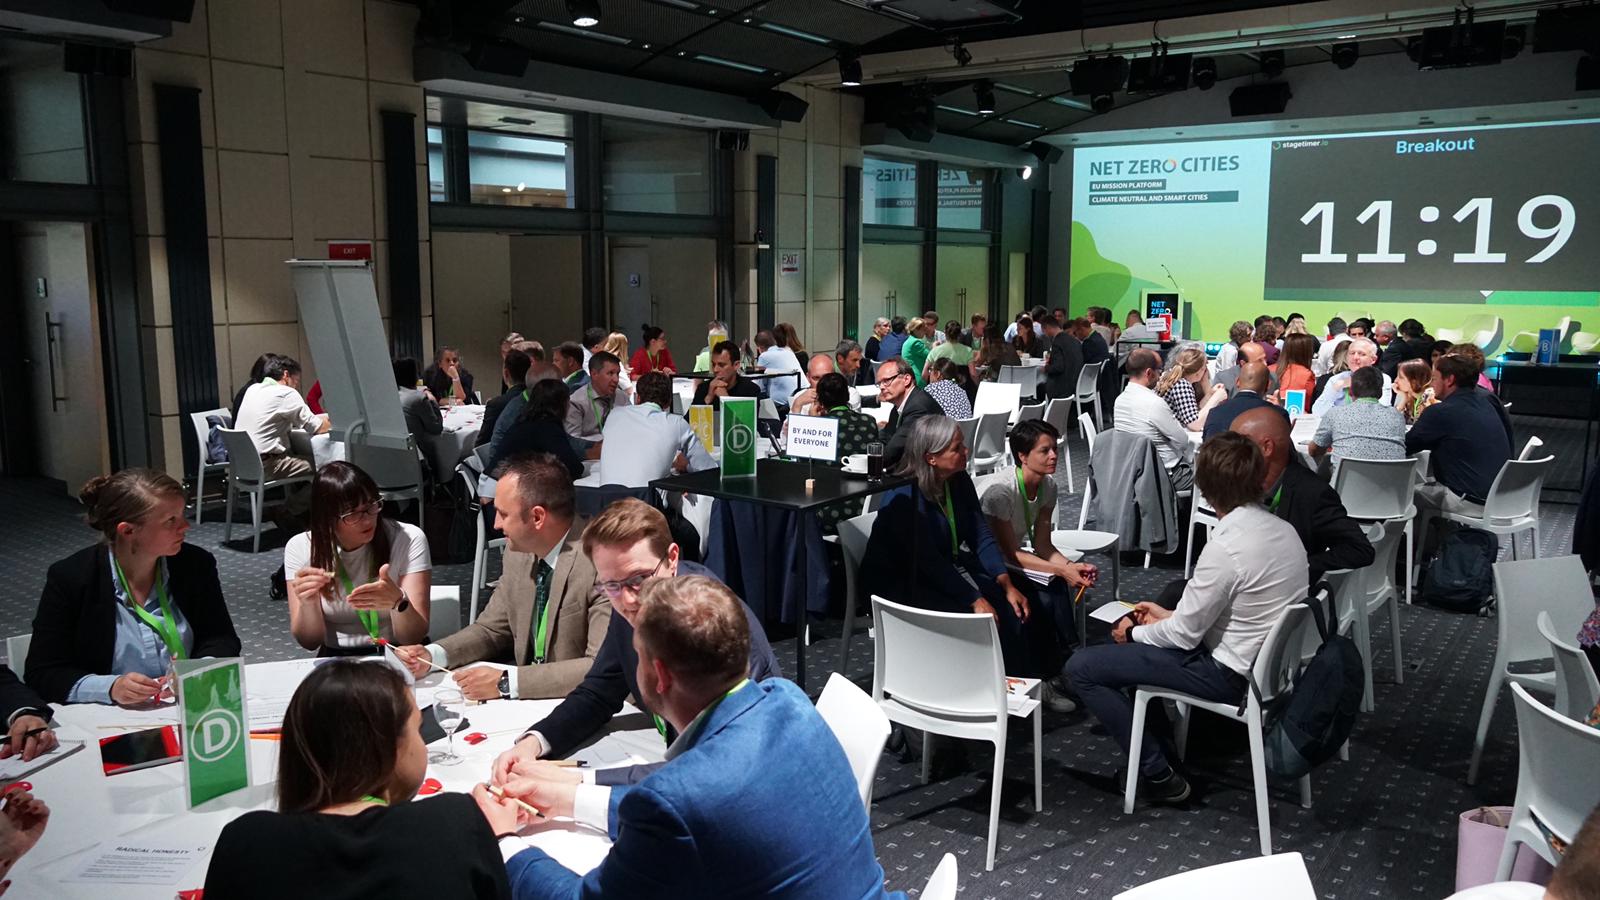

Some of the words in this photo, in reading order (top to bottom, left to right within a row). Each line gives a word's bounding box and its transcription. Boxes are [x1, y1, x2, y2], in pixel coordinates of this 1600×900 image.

[1395, 137, 1476, 154] Breakout
[1090, 160, 1124, 176] NET
[1128, 158, 1177, 175] ZERO
[1181, 155, 1240, 173] CITIES
[1092, 182, 1101, 190] EU
[1101, 182, 1128, 190] MISSION
[1128, 181, 1163, 189] PLATFORM
[1091, 196, 1119, 204] CLIMATE
[1119, 195, 1149, 203] NEUTRAL
[1163, 194, 1187, 202] SMART
[1187, 193, 1209, 201] CITIES
[1299, 194, 1577, 263] 11:19
[782, 254, 798, 265] EXIT
[732, 429, 748, 449] D
[792, 427, 801, 435] BY
[802, 428, 817, 437] AND
[818, 429, 833, 438] FOR
[794, 437, 829, 448] EVERYONE
[202, 717, 232, 754] D
